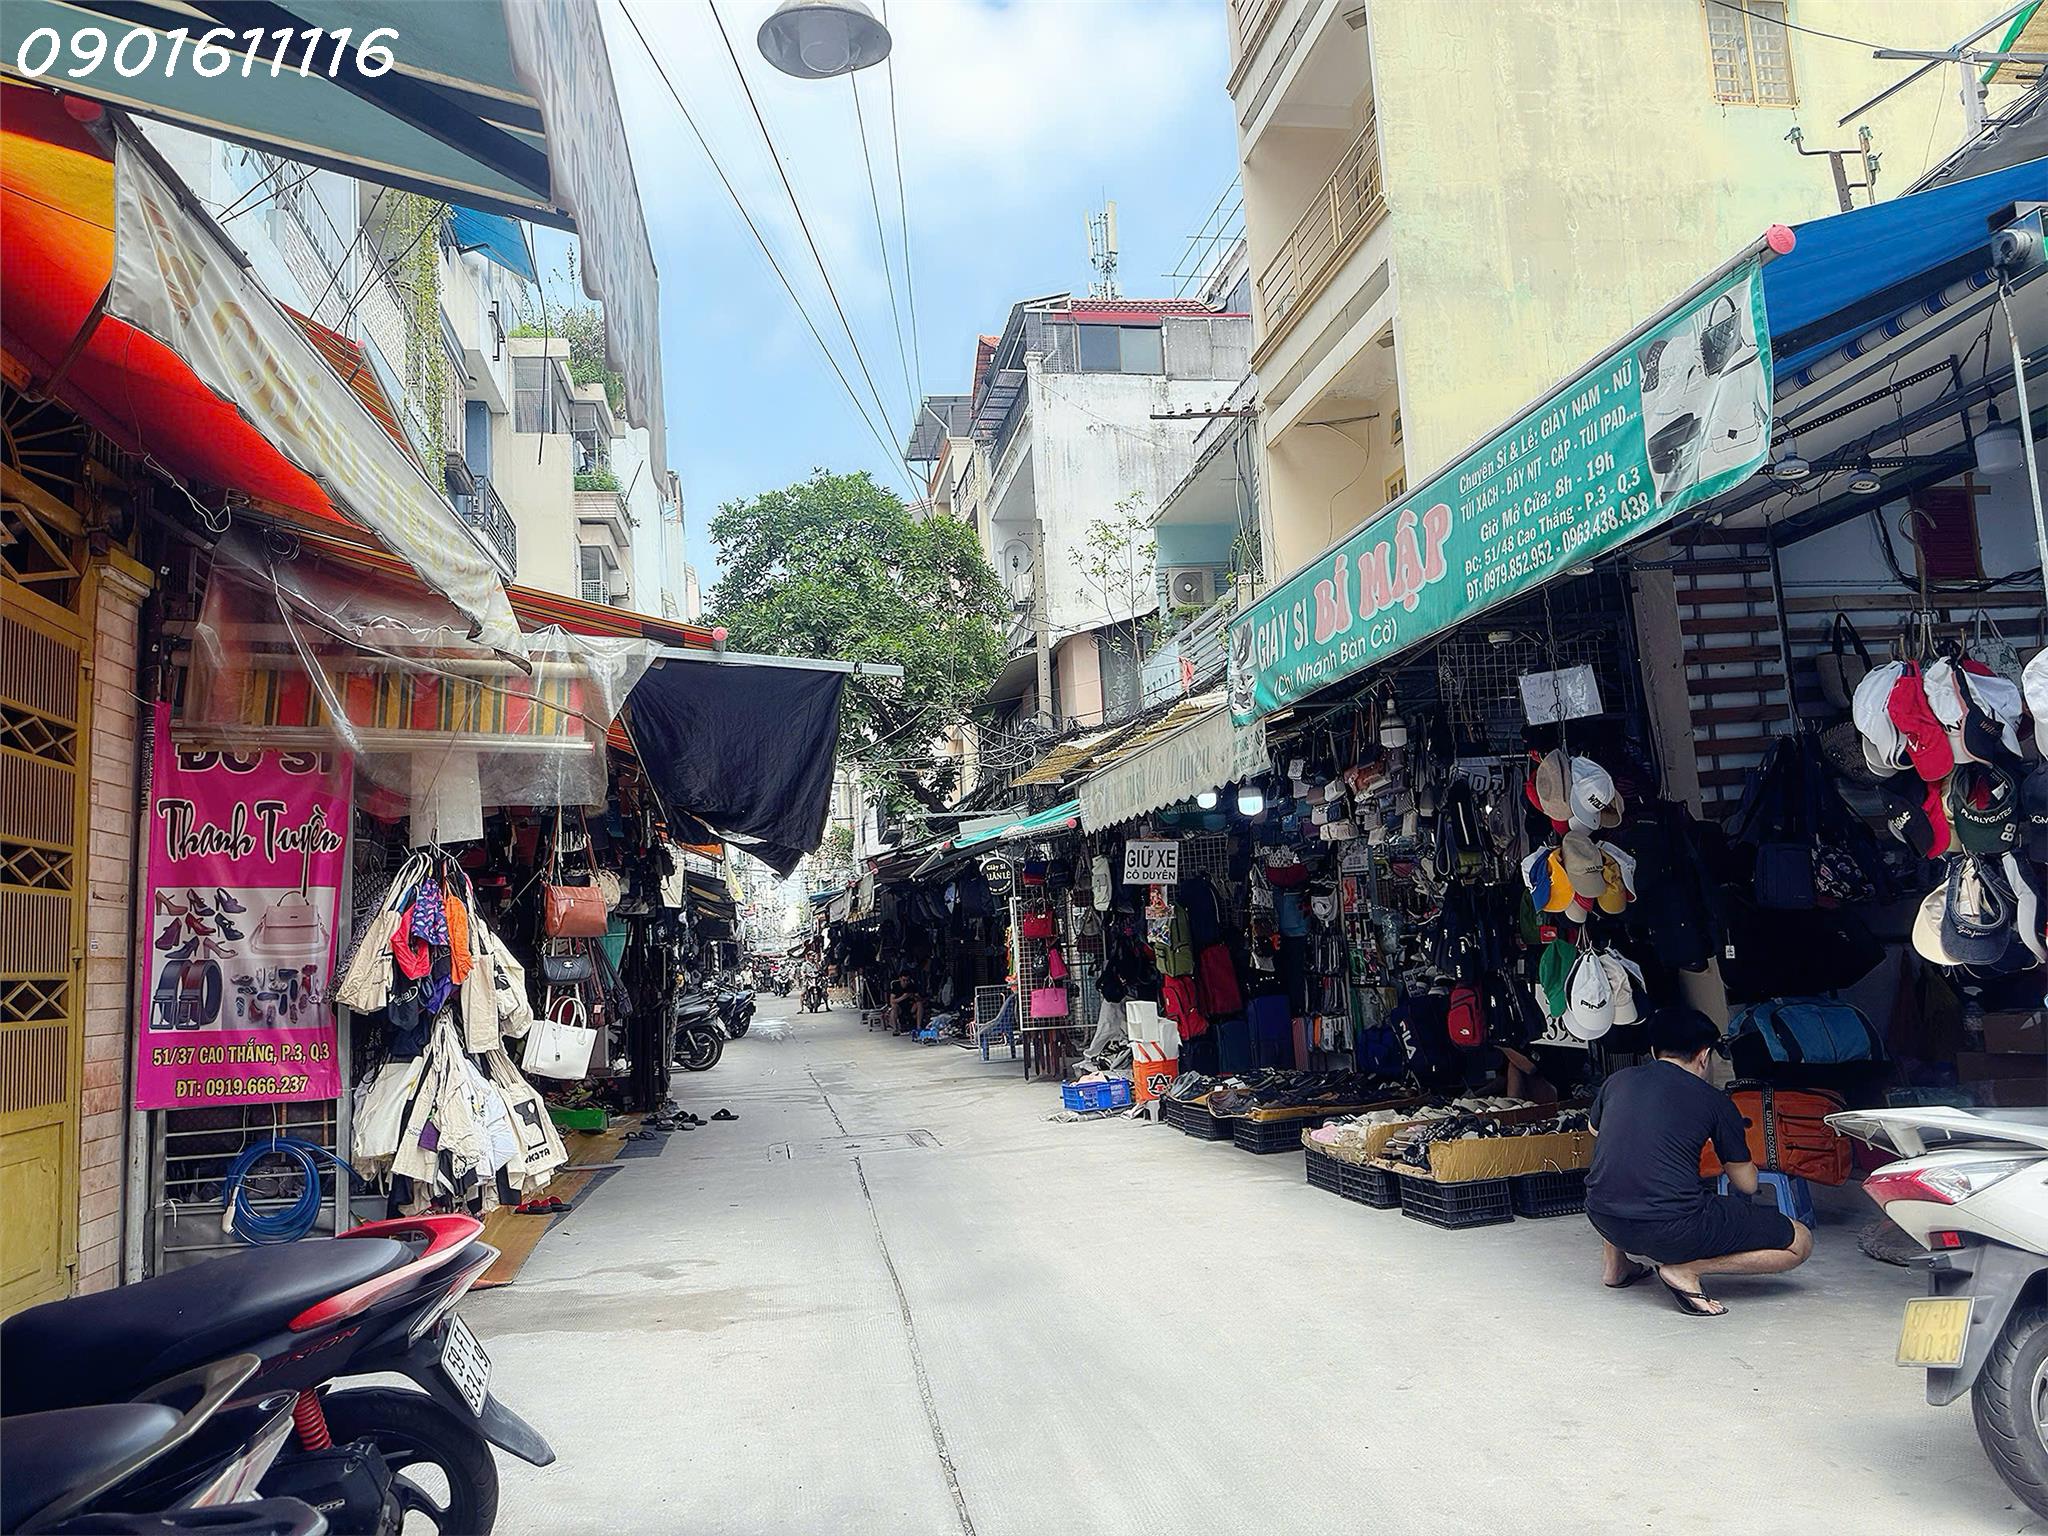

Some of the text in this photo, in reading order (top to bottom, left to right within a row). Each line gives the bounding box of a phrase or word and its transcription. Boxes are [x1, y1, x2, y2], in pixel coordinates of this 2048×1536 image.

[1459, 461, 1494, 494] Chuyên
[1509, 441, 1519, 461] &
[1540, 405, 1569, 440] GIÀY
[1571, 384, 1601, 420] NAM
[1612, 358, 1633, 391] NỮ
[1460, 499, 1475, 523] TÚI
[1476, 485, 1499, 514] XÁCH
[1506, 468, 1525, 496] DÂY
[1526, 456, 1542, 483] NỊT
[1579, 419, 1597, 449] TÚI
[1600, 404, 1637, 438] IPAD...
[1465, 556, 1482, 576] ĐC:
[1484, 538, 1515, 567] 51/48
[1517, 527, 1536, 549] Cao
[1538, 505, 1574, 534] Thắng
[1585, 486, 1607, 512] P.3
[1617, 466, 1641, 495] Q.3
[1480, 515, 1499, 542] Giờ
[1501, 502, 1521, 531] Mở
[1523, 489, 1552, 519] Cửa:
[1555, 476, 1573, 500] 8h
[1586, 451, 1615, 482] 19h
[1466, 576, 1483, 603] ĐT:
[1484, 539, 1554, 594] 0979.852.952
[1561, 492, 1650, 553] 0963.438.438
[1257, 606, 1289, 672] GIÀY
[1314, 553, 1353, 645] BÍ
[1358, 504, 1452, 621] MẬP
[1273, 672, 1294, 699] (Chi
[1296, 650, 1338, 684] Nhánh
[1340, 636, 1367, 664] Bàn
[157, 798, 343, 896] Thanh Tuyền
[1125, 869, 1176, 880] CÔ DUYÊN
[1126, 845, 1176, 868] GIỮ XE
[1399, 1020, 1417, 1060] FILA
[1580, 998, 1607, 1010] PING
[152, 1037, 331, 1067] 51/37 CAO THẮNG, P.3, Q.3
[175, 1075, 309, 1099] ĐT: 0919.666.237
